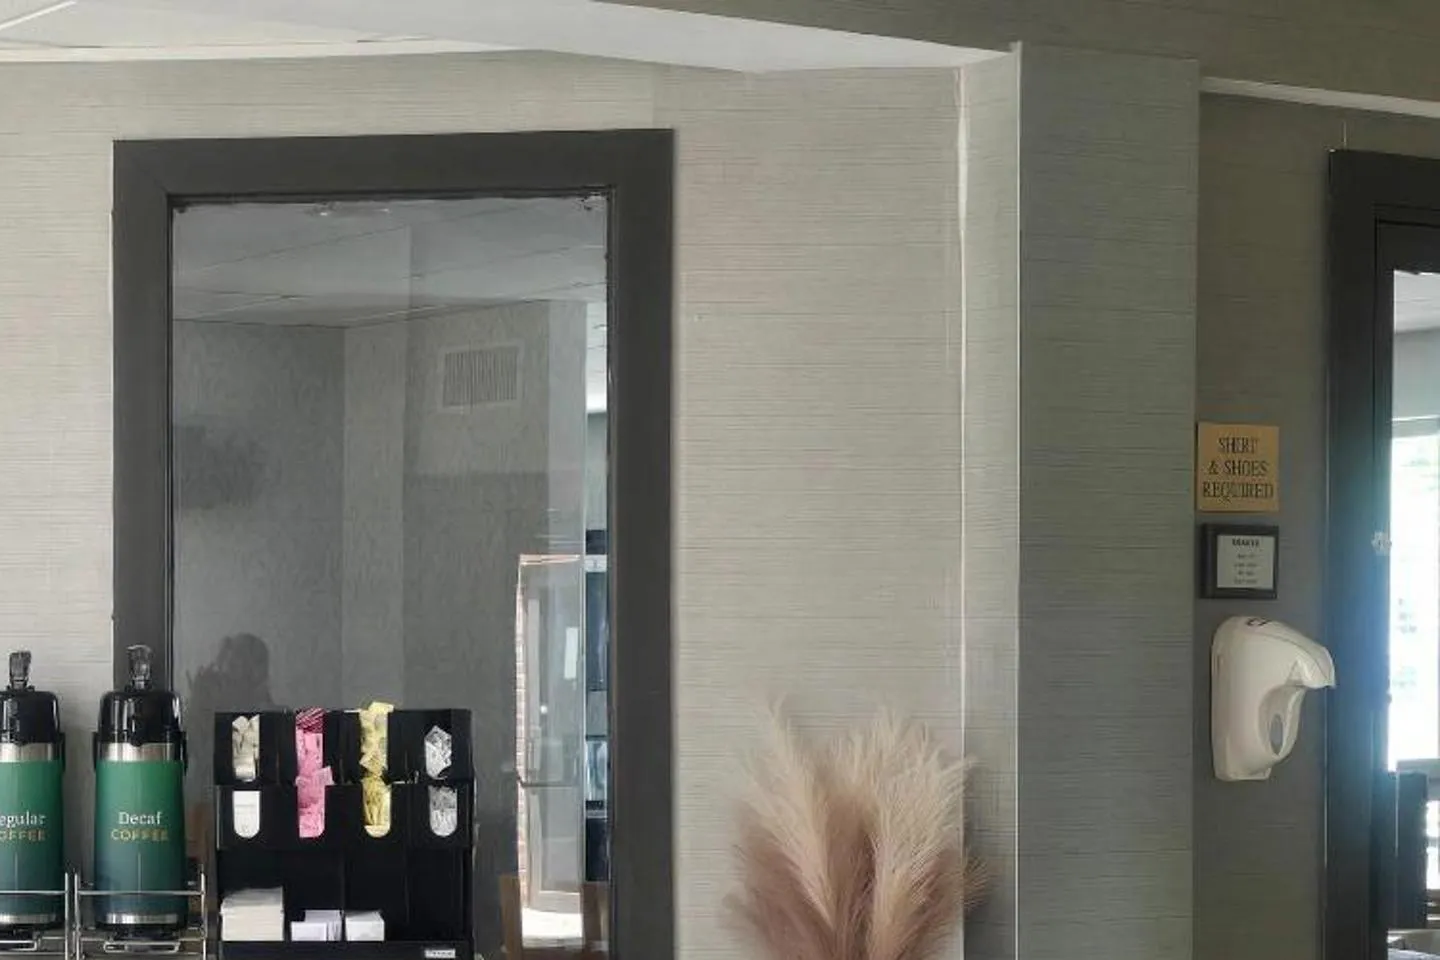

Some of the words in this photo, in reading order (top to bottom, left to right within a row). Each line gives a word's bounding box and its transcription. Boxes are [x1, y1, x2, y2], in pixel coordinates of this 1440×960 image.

[1208, 460, 1220, 475] &
[1223, 460, 1269, 476] SHOES
[1202, 481, 1274, 502] REQUIRED
[118, 811, 162, 825] Decaf
[111, 828, 169, 841] COFFEE
